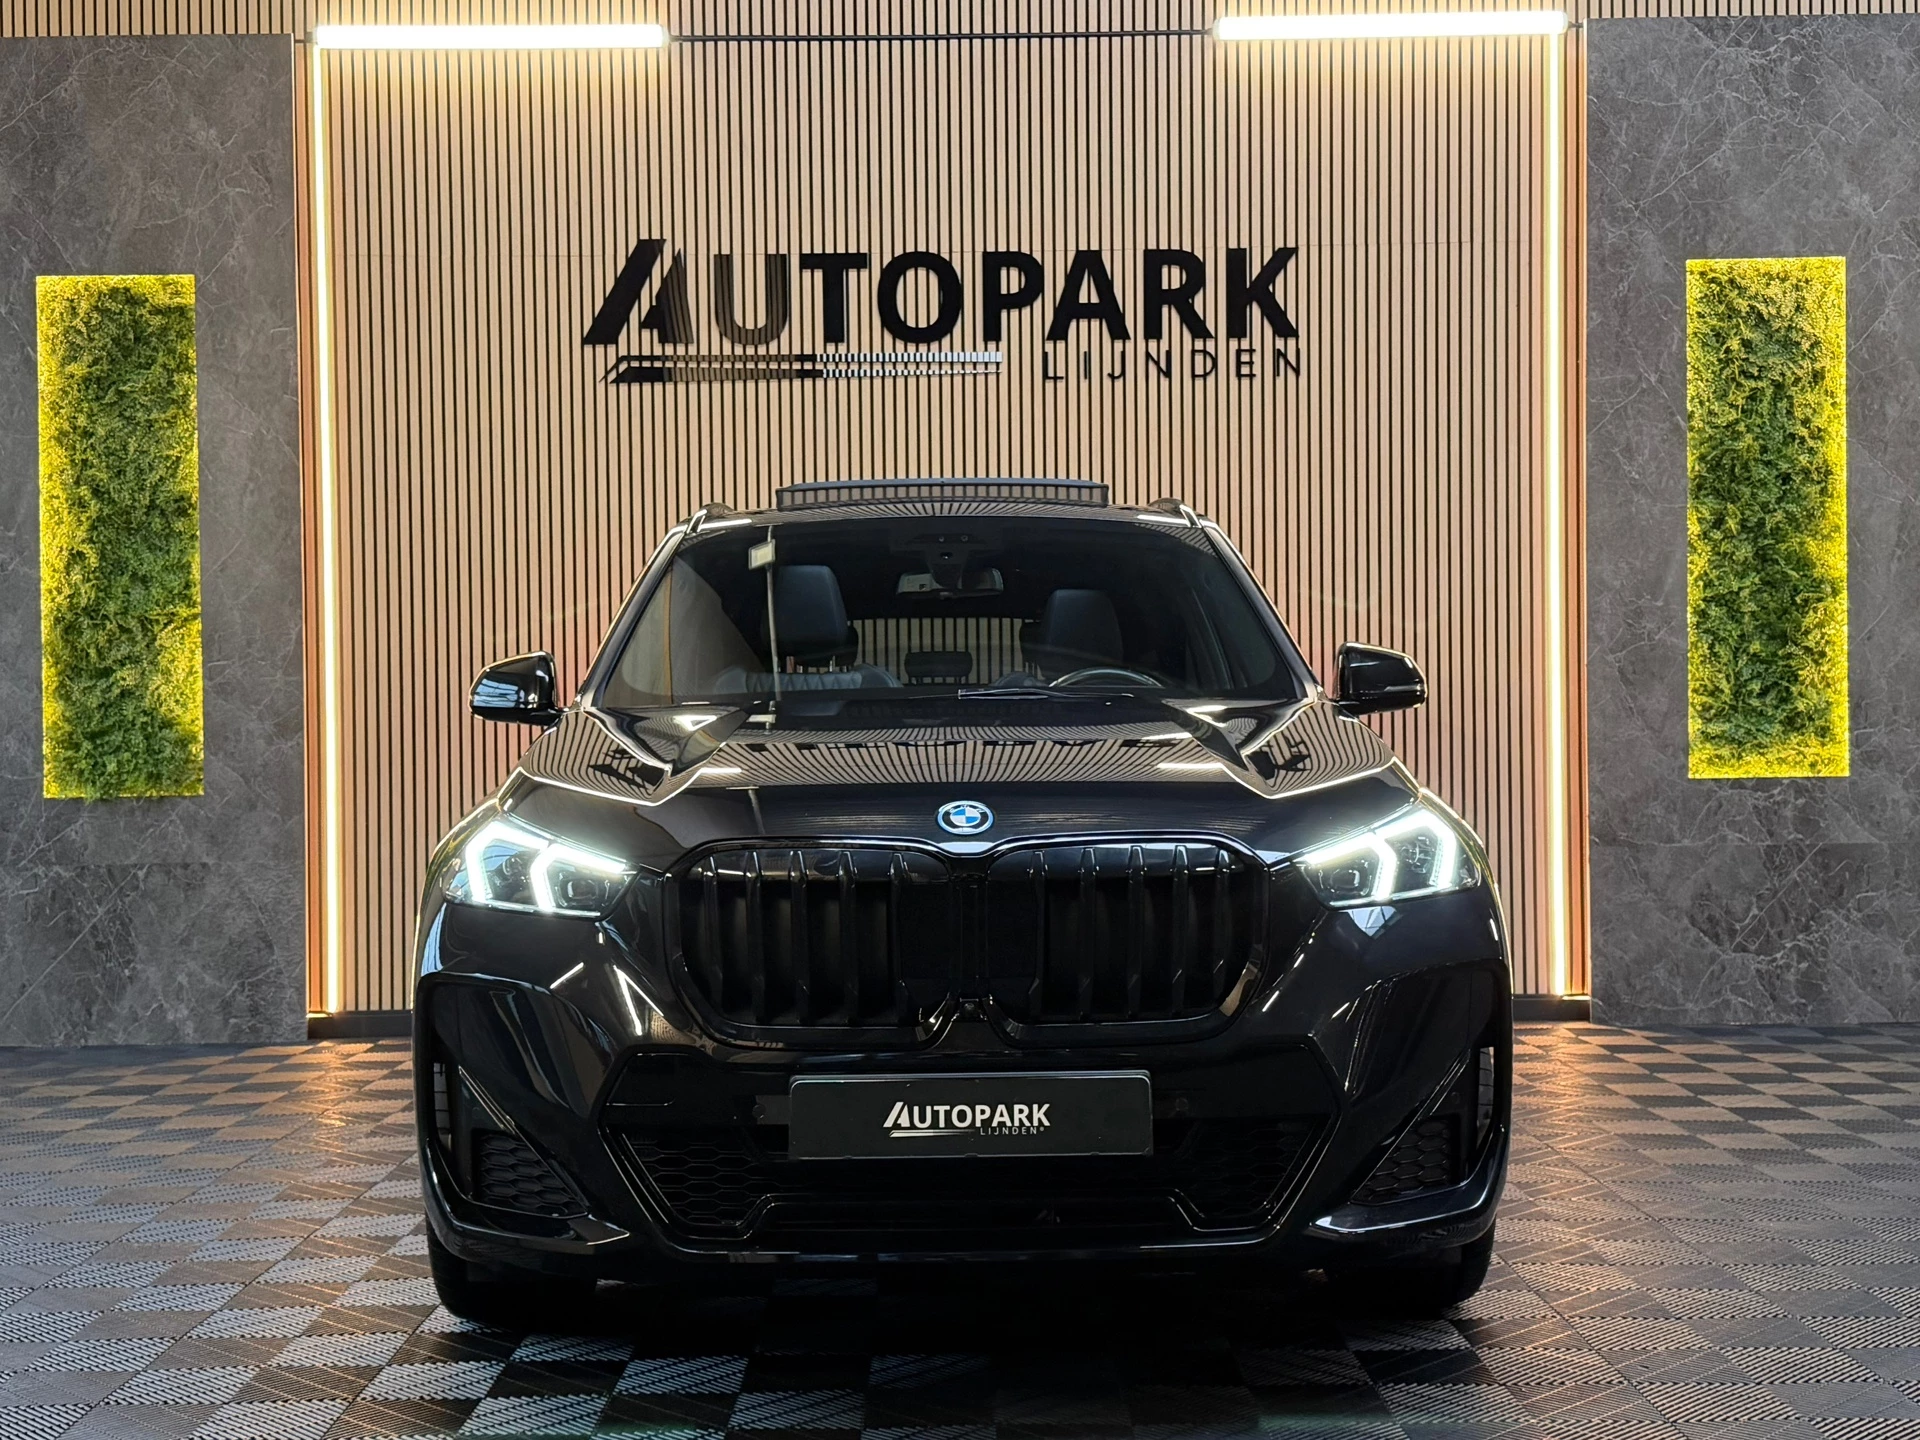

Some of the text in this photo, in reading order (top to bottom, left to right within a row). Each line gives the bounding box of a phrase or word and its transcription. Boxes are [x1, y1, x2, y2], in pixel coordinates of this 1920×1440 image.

[581, 238, 1299, 346] AUTOPARK
[1043, 348, 1301, 381] LIJNDEN
[883, 1101, 1051, 1128] AUTOPARK
